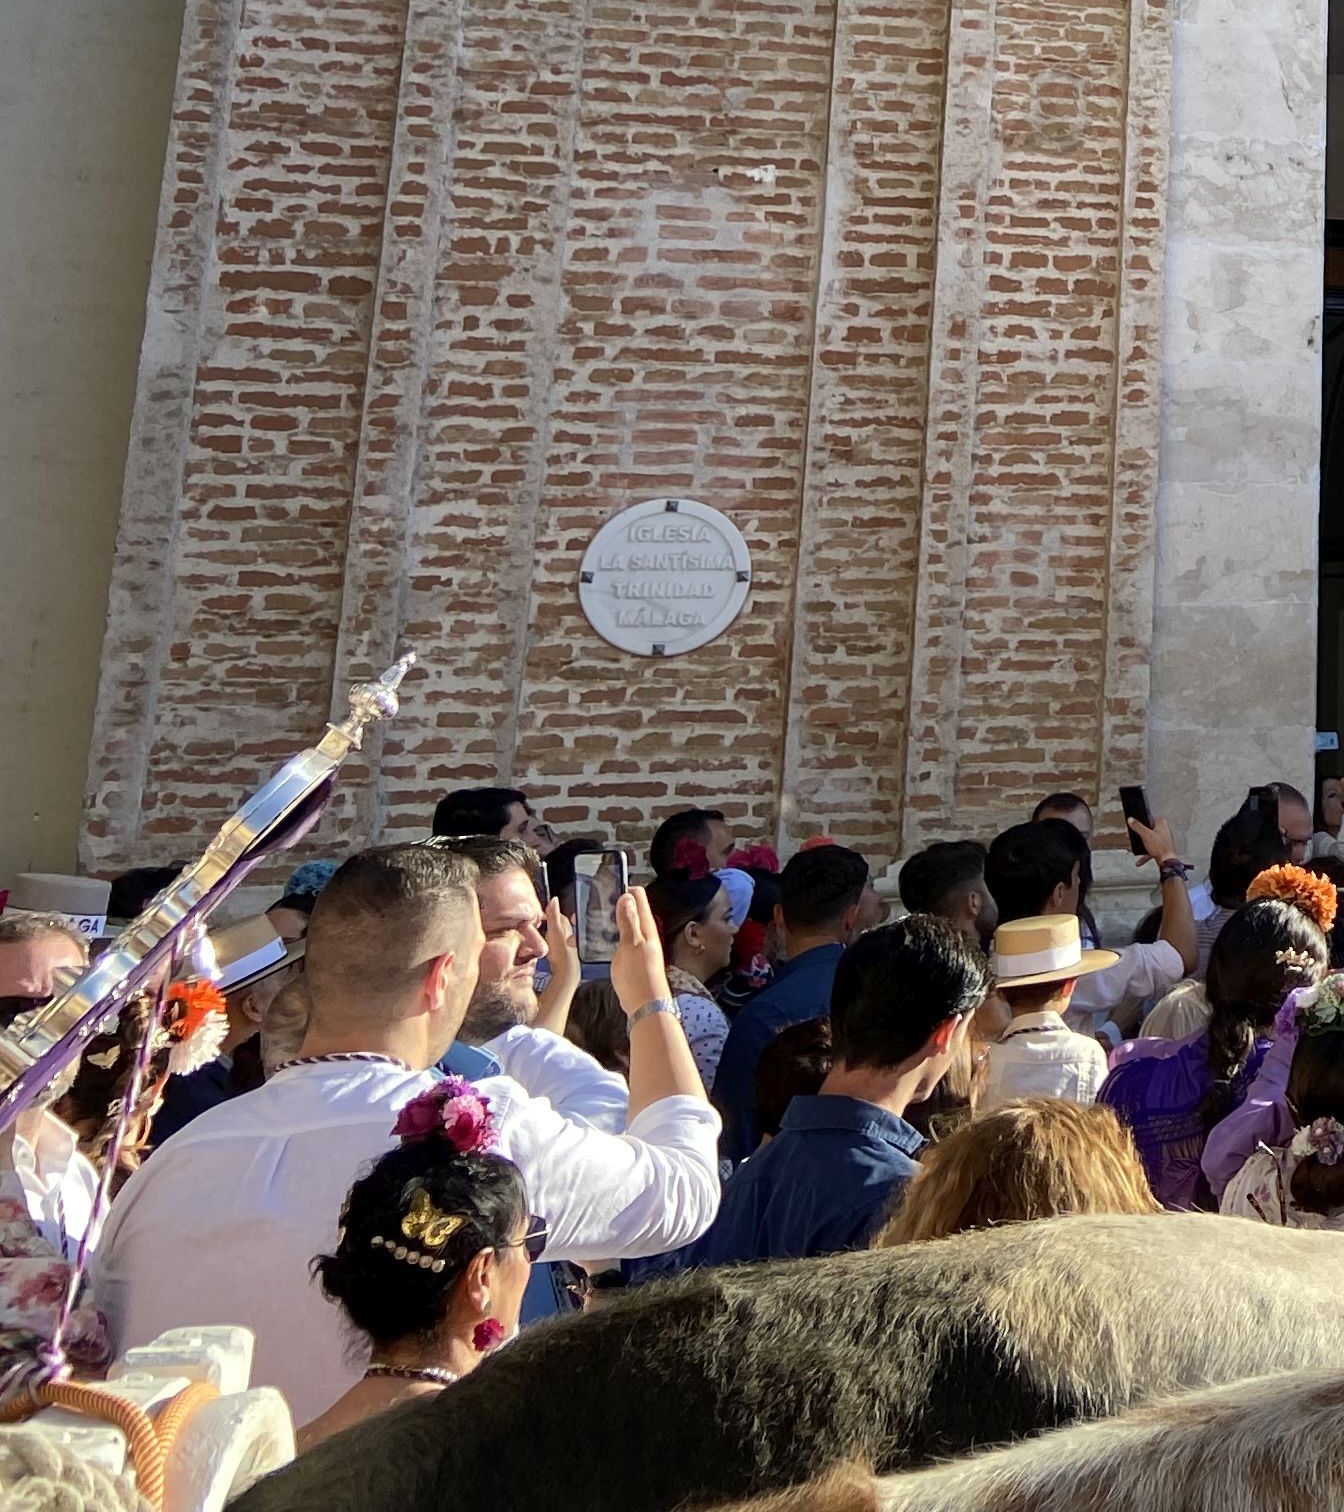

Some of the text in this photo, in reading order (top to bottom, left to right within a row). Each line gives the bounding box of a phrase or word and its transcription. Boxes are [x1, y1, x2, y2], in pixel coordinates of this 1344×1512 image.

[628, 525, 711, 543] IGLESIA
[599, 550, 735, 571] LA SANTÍSIMA
[613, 582, 714, 599] TRINIDAD
[616, 607, 706, 627] MÁLAGA
